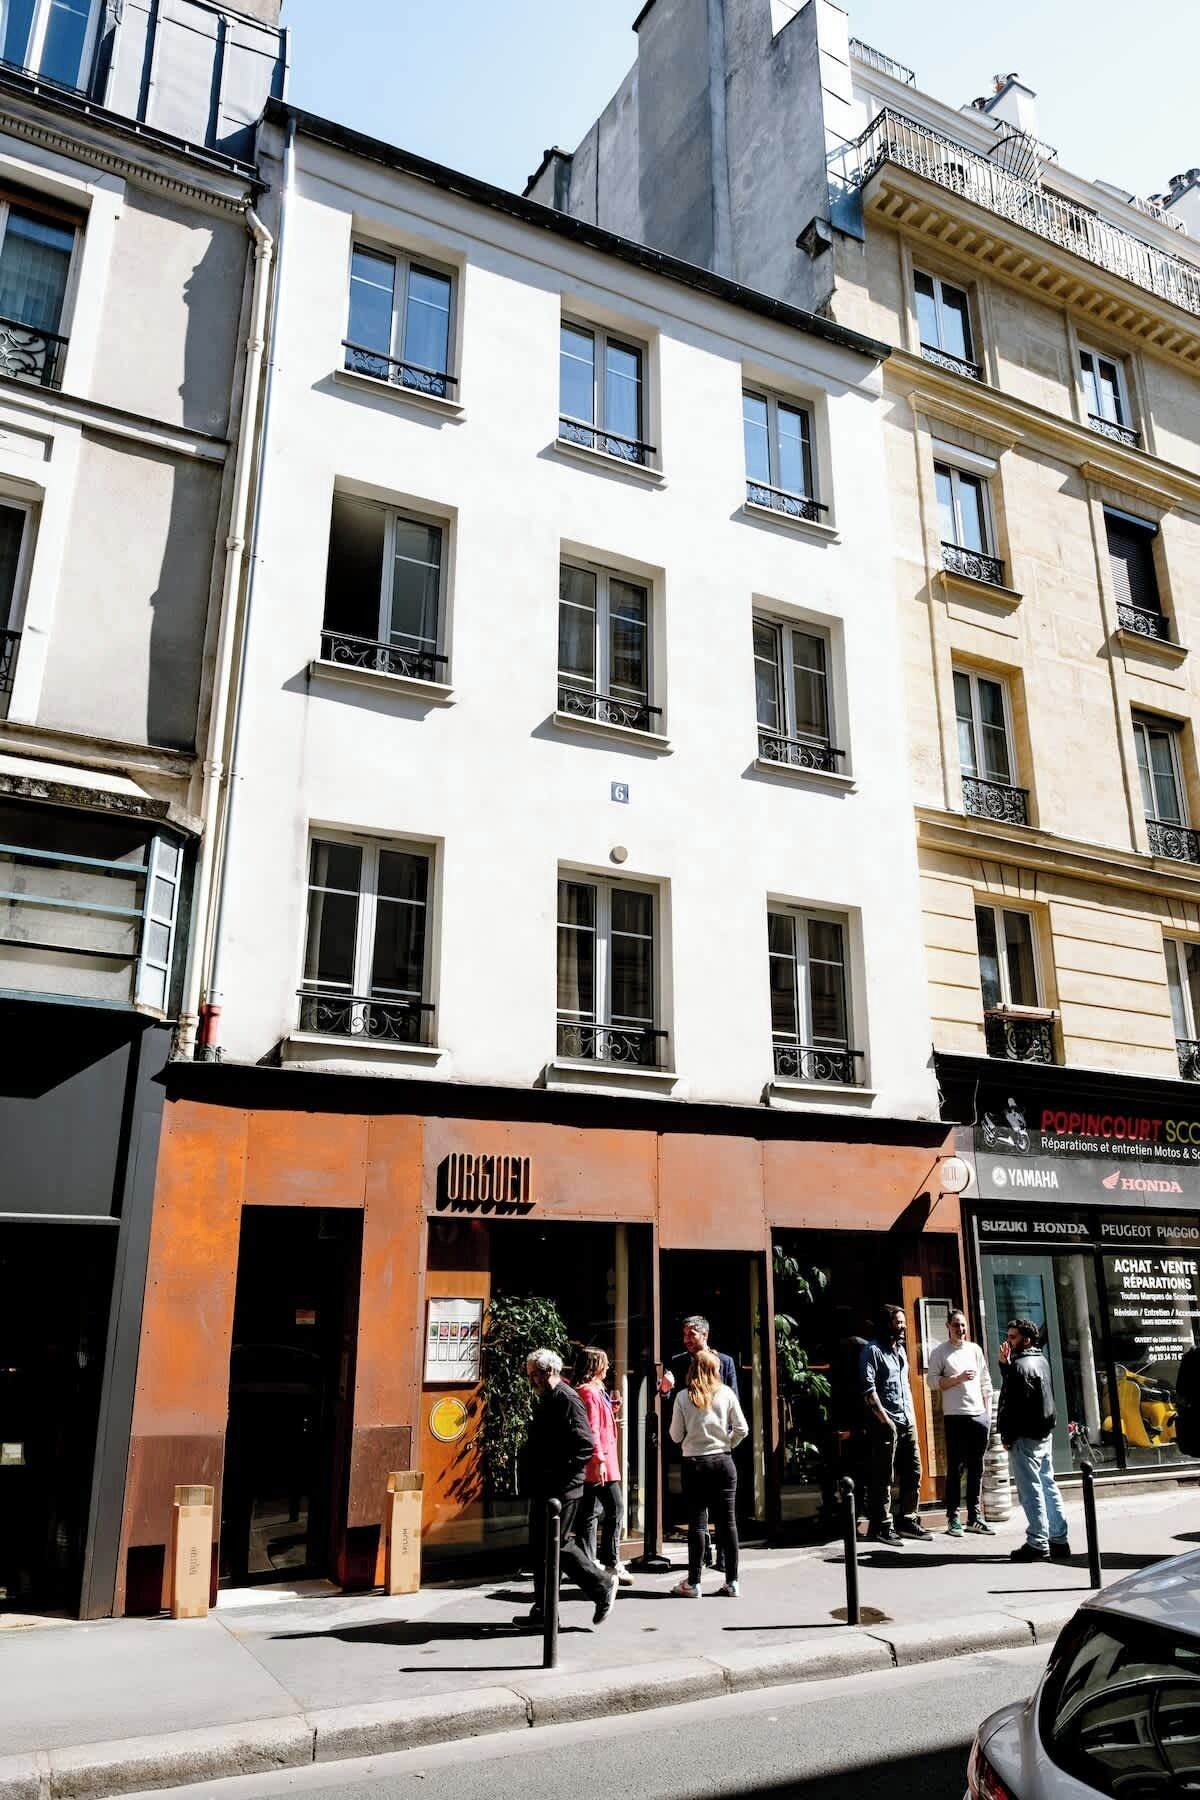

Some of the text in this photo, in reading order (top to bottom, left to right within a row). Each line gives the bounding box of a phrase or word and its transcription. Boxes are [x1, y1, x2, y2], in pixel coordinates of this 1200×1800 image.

[615, 785, 625, 800] 6
[1040, 1110, 1162, 1141] POPINCOURT
[1041, 1137, 1098, 1153] Réparations
[1100, 1142, 1110, 1153] et
[1111, 1143, 1153, 1157] entretien
[1154, 1145, 1181, 1159] Motos
[1182, 1147, 1190, 1159] &
[447, 1152, 537, 1203] ORGUEIL
[1008, 1168, 1059, 1189] YAMAHA
[1121, 1178, 1183, 1193] HONDA
[981, 1220, 1089, 1235] SUZUKI HONDA
[1101, 1224, 1199, 1239] PEUGEOT PIAGGIO
[1114, 1259, 1152, 1273] ACHAT
[1160, 1260, 1198, 1275] VENTE
[1124, 1274, 1192, 1289] RÉPARATIONS
[1120, 1292, 1140, 1300] Toutes
[1140, 1292, 1165, 1302] Marques
[1165, 1292, 1173, 1300] de
